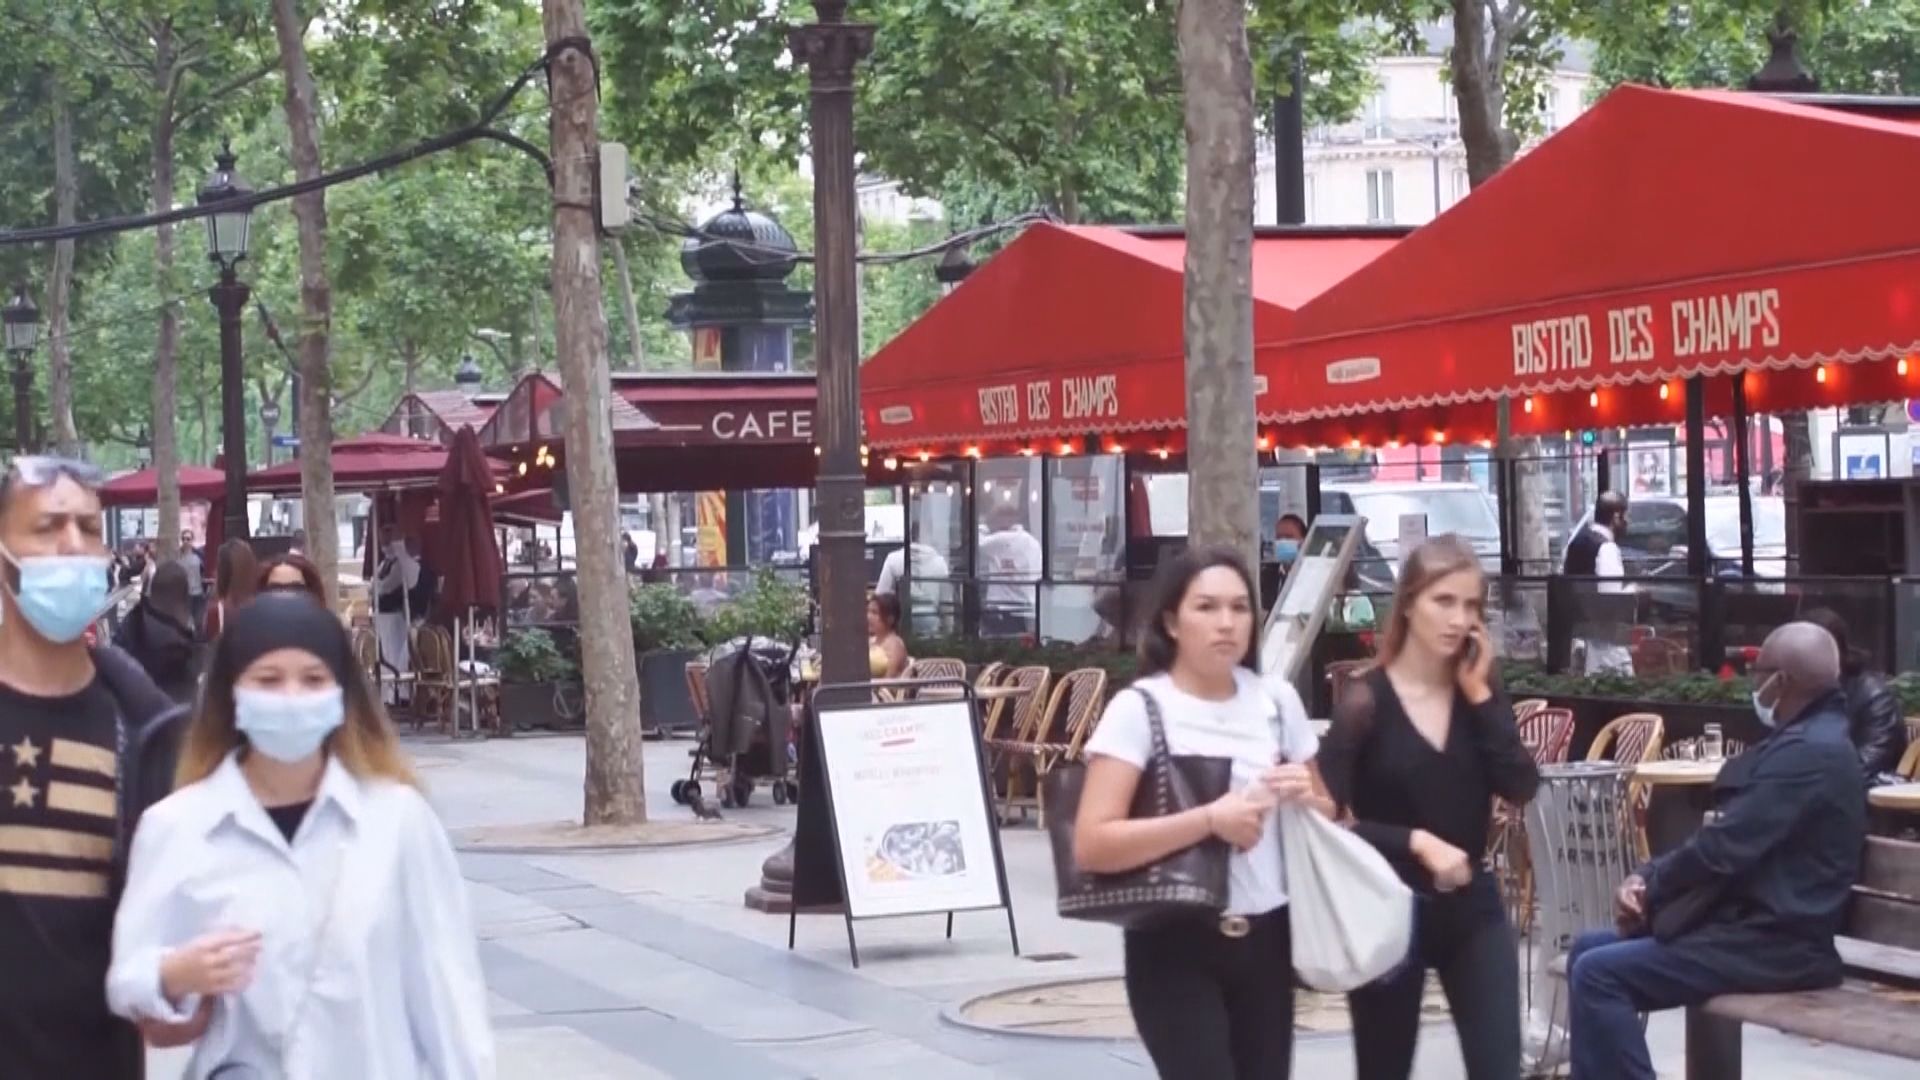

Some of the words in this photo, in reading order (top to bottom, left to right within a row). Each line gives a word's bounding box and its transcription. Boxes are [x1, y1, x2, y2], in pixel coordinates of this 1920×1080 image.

[1511, 314, 1592, 375] BISTRO
[1608, 305, 1655, 363] DES
[1671, 288, 1780, 356] CHAMPS
[711, 410, 812, 439] CAFE
[978, 383, 1019, 425] BISTRO
[1027, 380, 1050, 421] DES
[1062, 374, 1118, 419] CHAMPS
